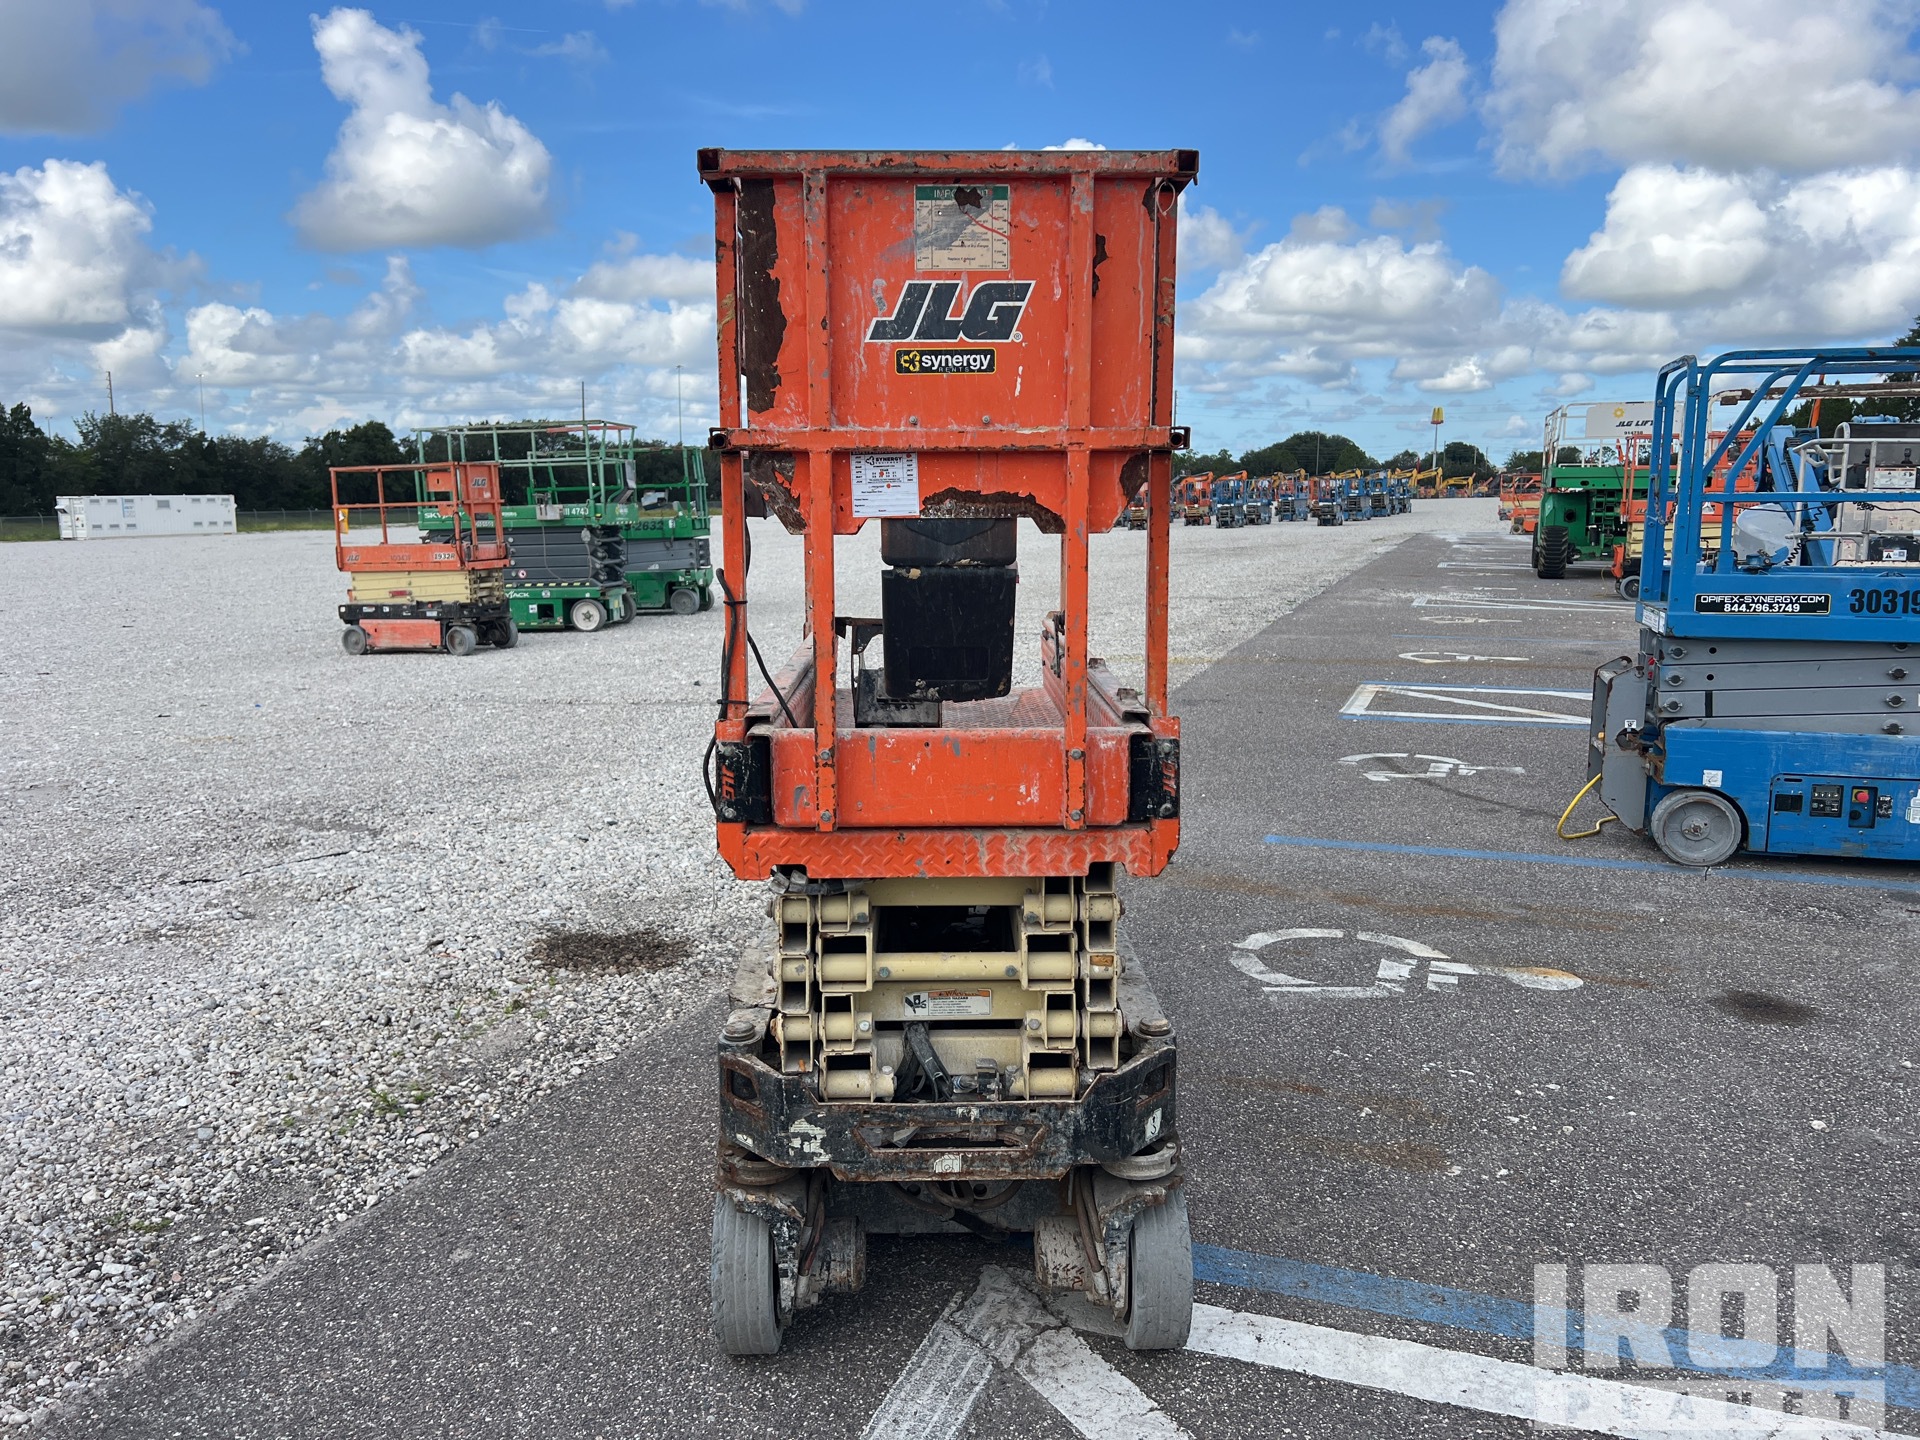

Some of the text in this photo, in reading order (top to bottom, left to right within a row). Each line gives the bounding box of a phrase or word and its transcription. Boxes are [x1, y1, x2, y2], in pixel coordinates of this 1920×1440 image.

[864, 280, 1036, 342] JLG
[921, 354, 991, 370] synergy
[472, 477, 488, 487] JLG
[1700, 595, 1825, 604] OPIFEX-SYNERGY.COM
[1723, 603, 1800, 612] 844.796.3749
[721, 764, 735, 801] JLG
[1162, 760, 1176, 798] JLG
